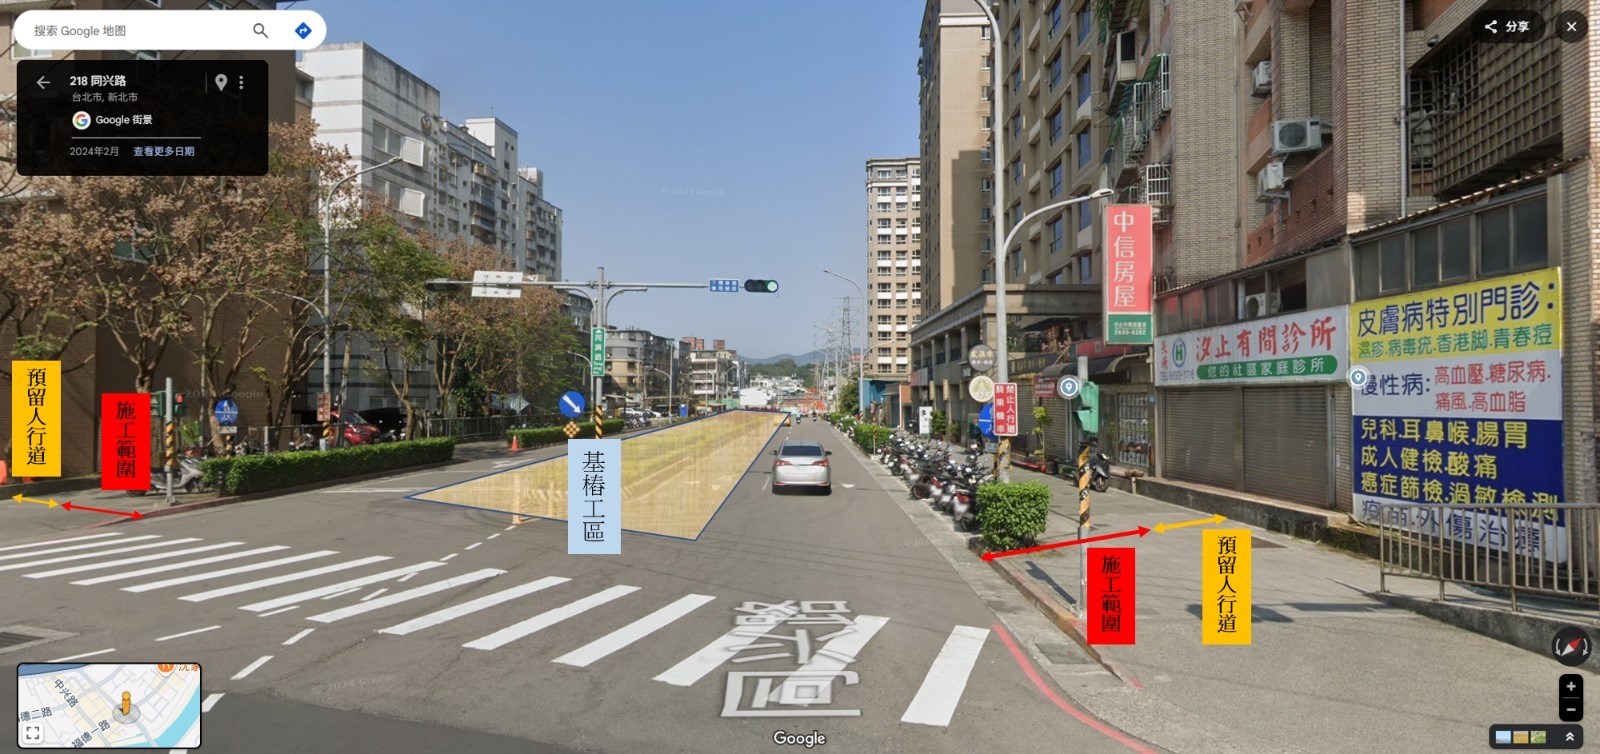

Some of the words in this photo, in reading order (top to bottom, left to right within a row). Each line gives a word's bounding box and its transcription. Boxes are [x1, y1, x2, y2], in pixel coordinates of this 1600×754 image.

[1113, 210, 1136, 308] 中信房屋
[1195, 316, 1337, 362] 汐止有間診所
[1207, 357, 1326, 379] 您的社區家庭診所
